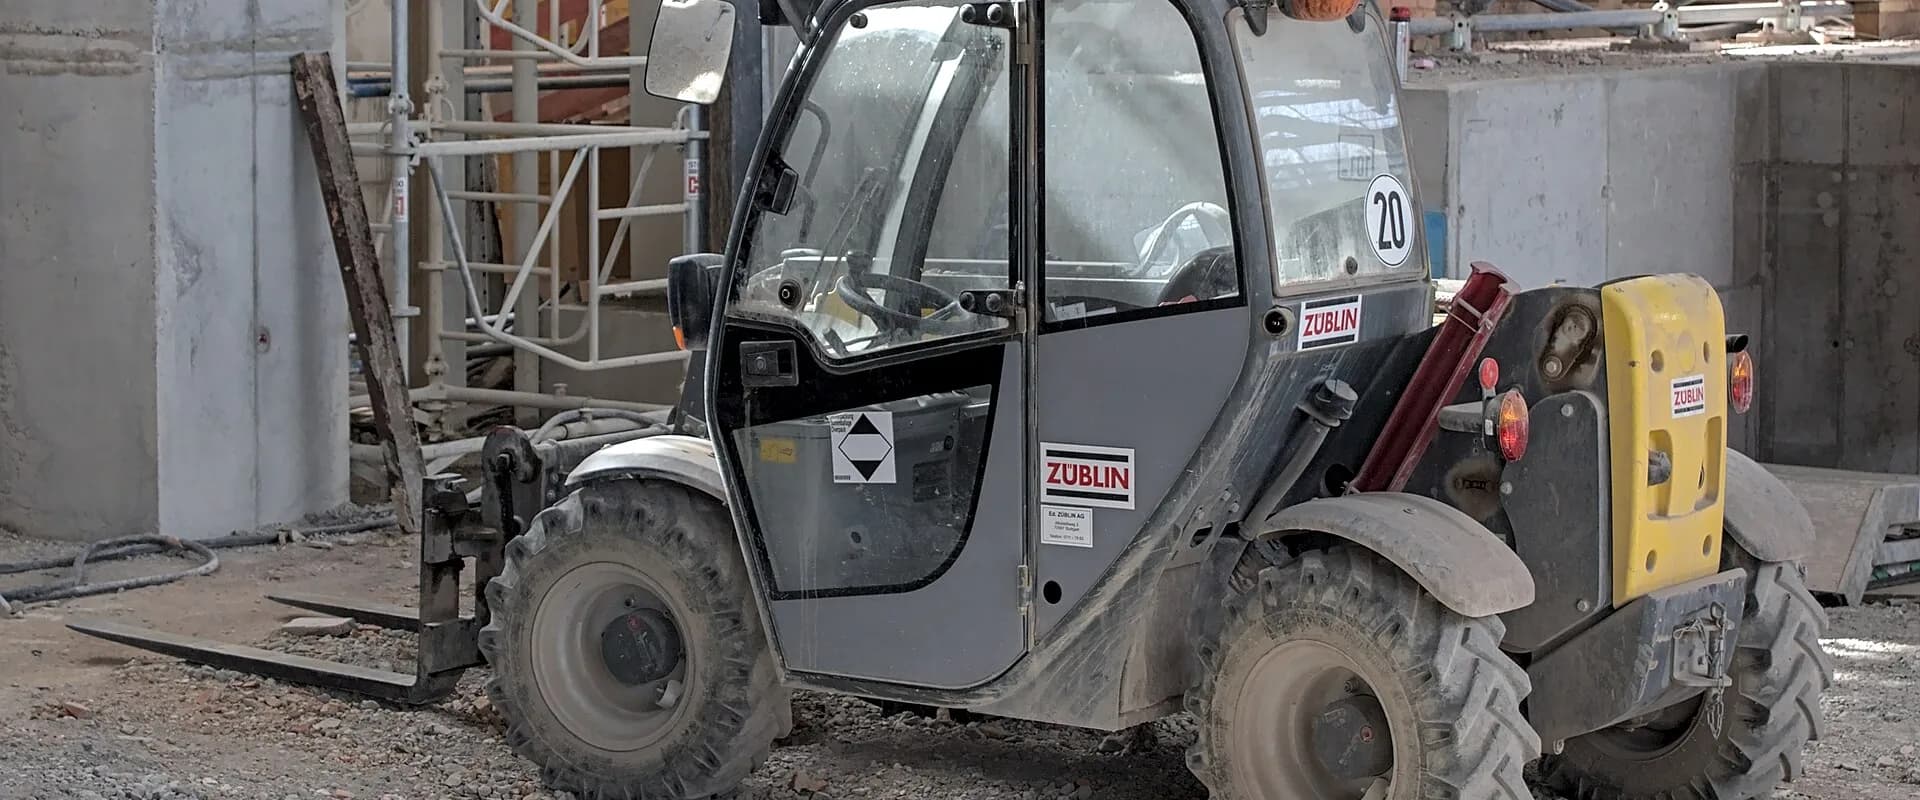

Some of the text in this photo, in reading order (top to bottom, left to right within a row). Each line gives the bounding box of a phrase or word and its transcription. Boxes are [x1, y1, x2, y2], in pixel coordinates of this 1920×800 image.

[1373, 191, 1406, 250] 20
[1303, 307, 1358, 337] ZÜBLIN
[1046, 462, 1129, 490] ZÜBLIN
